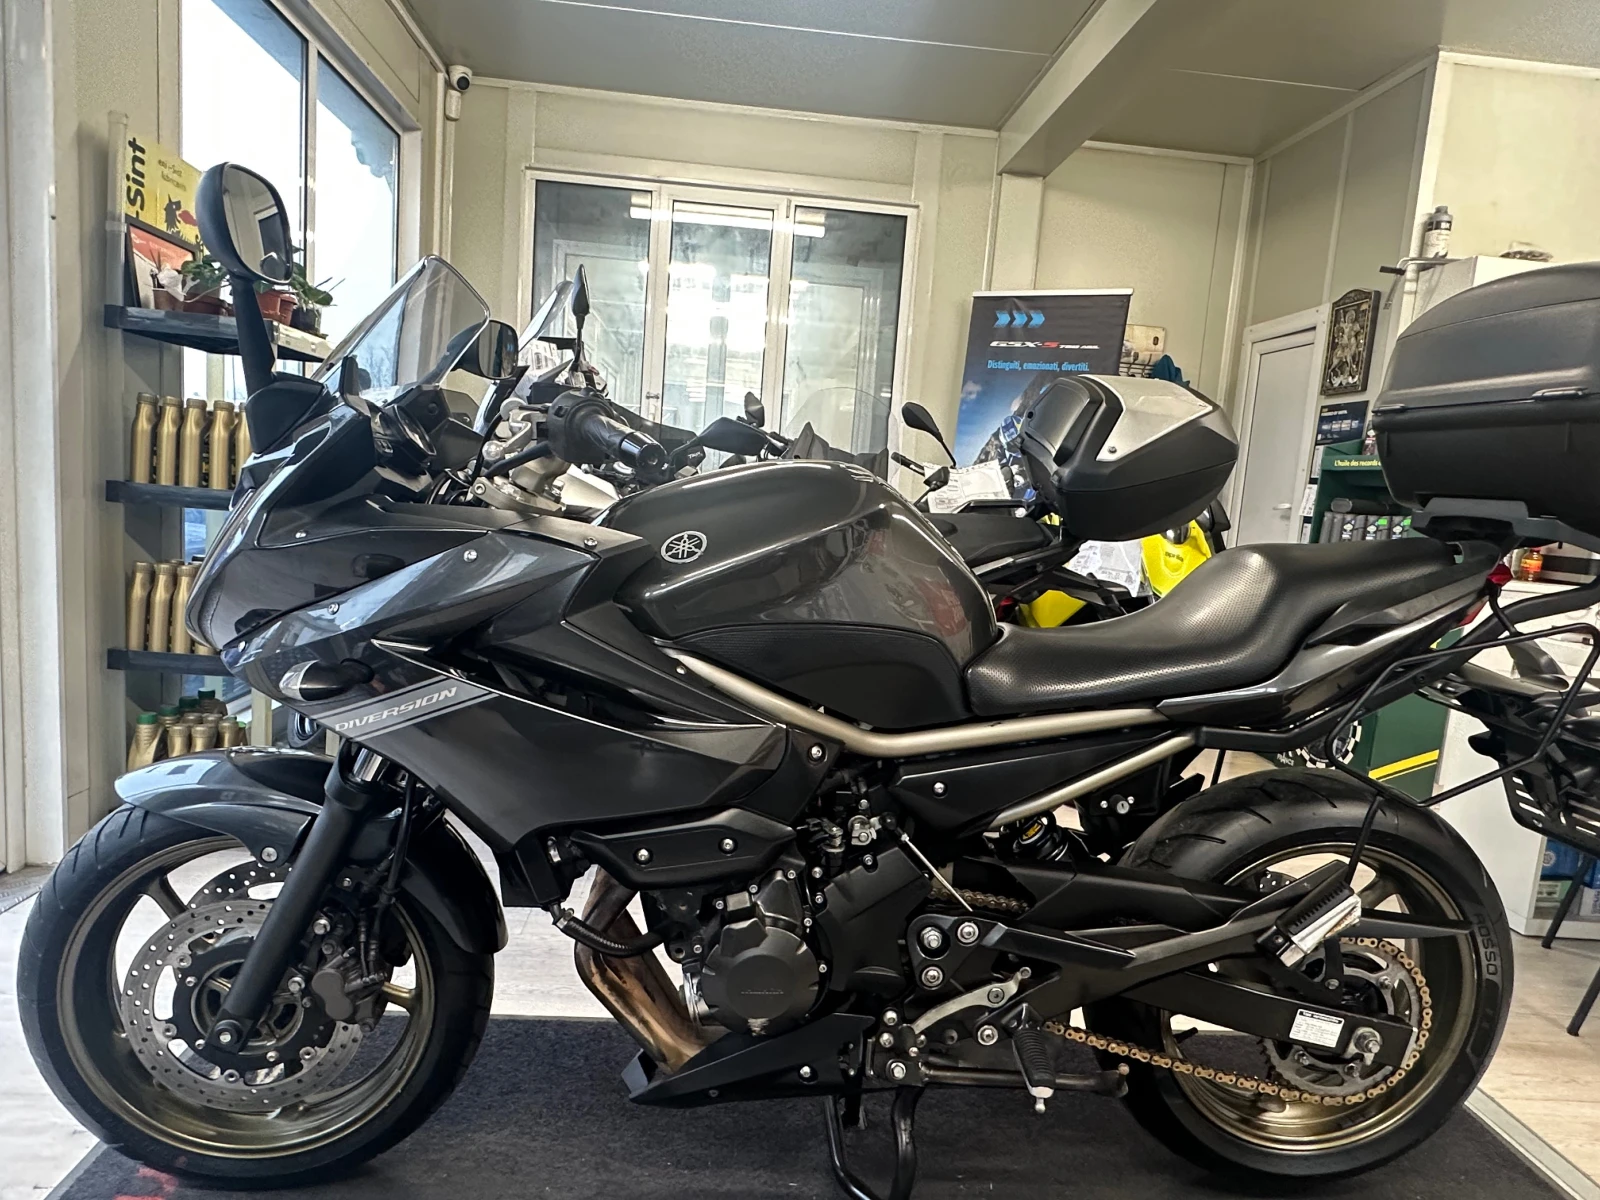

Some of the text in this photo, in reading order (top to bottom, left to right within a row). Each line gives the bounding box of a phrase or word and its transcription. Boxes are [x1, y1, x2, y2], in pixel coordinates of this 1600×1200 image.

[987, 360, 1090, 372] Distinguiti, emozionati, divertiti.
[335, 686, 458, 732] DIVERSION
[1474, 913, 1499, 977] ROSSO
